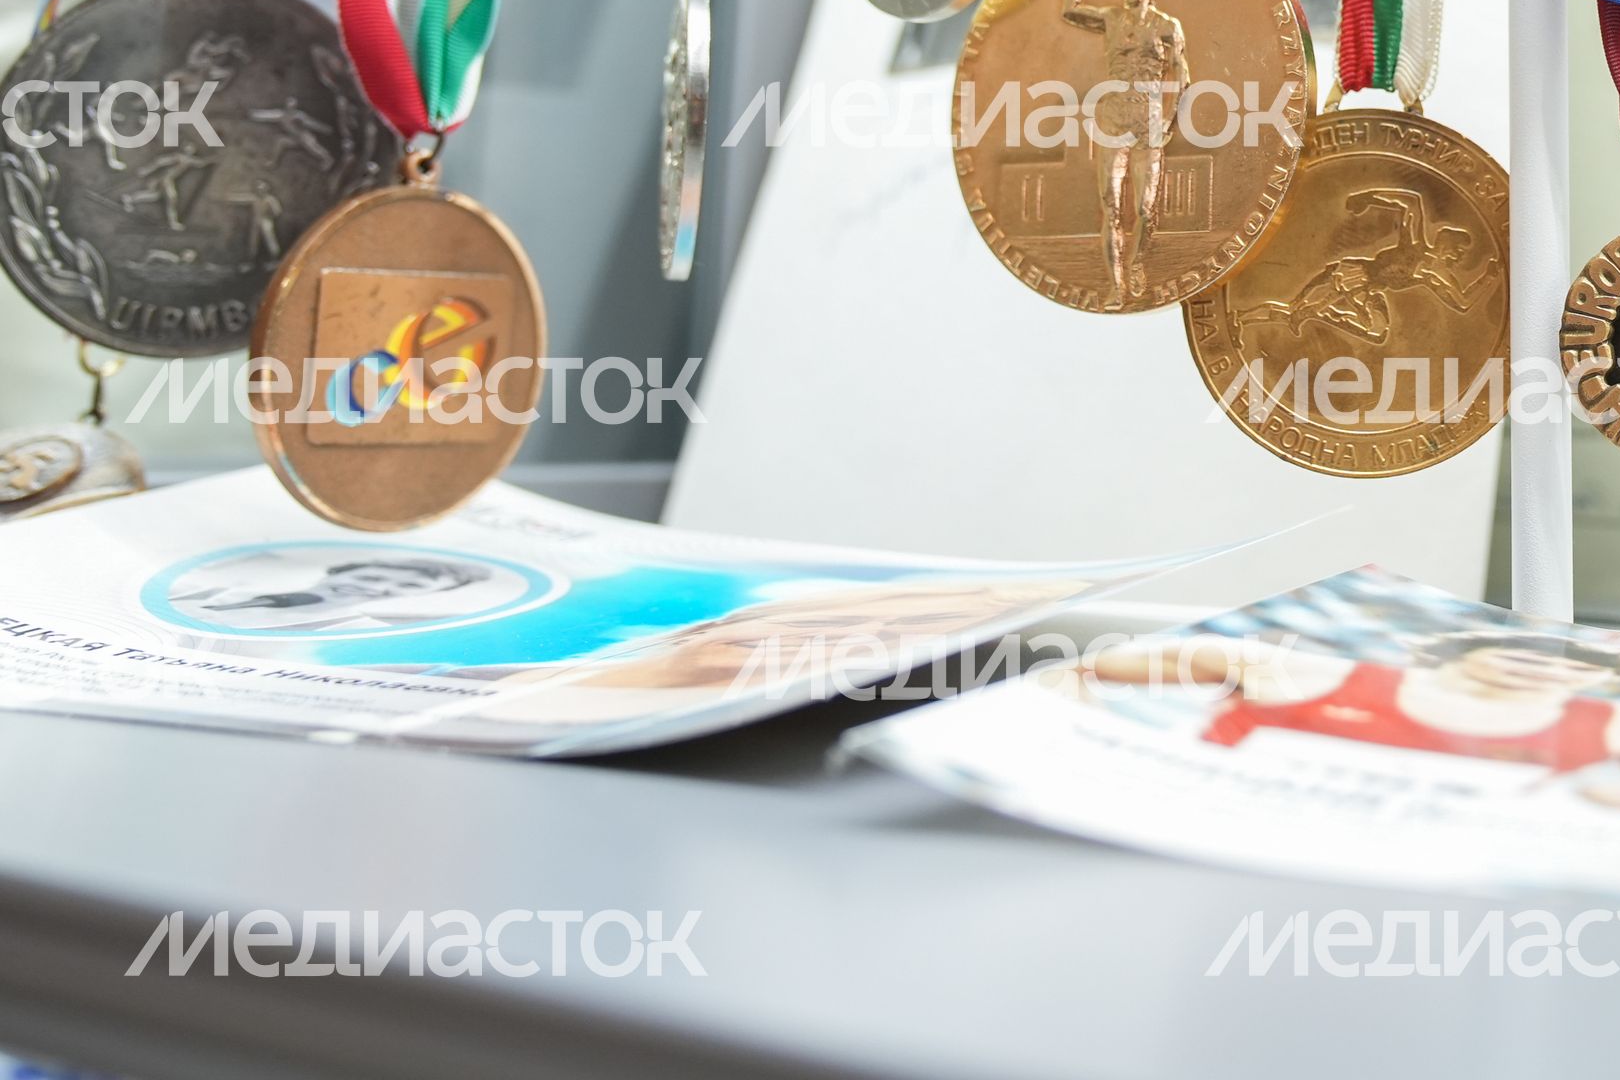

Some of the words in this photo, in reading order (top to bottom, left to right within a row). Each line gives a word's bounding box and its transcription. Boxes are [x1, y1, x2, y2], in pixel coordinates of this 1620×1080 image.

[1379, 122, 1476, 173] ТУРНИР
[112, 646, 257, 675] Татьяна
[261, 668, 499, 697] Николаевна
